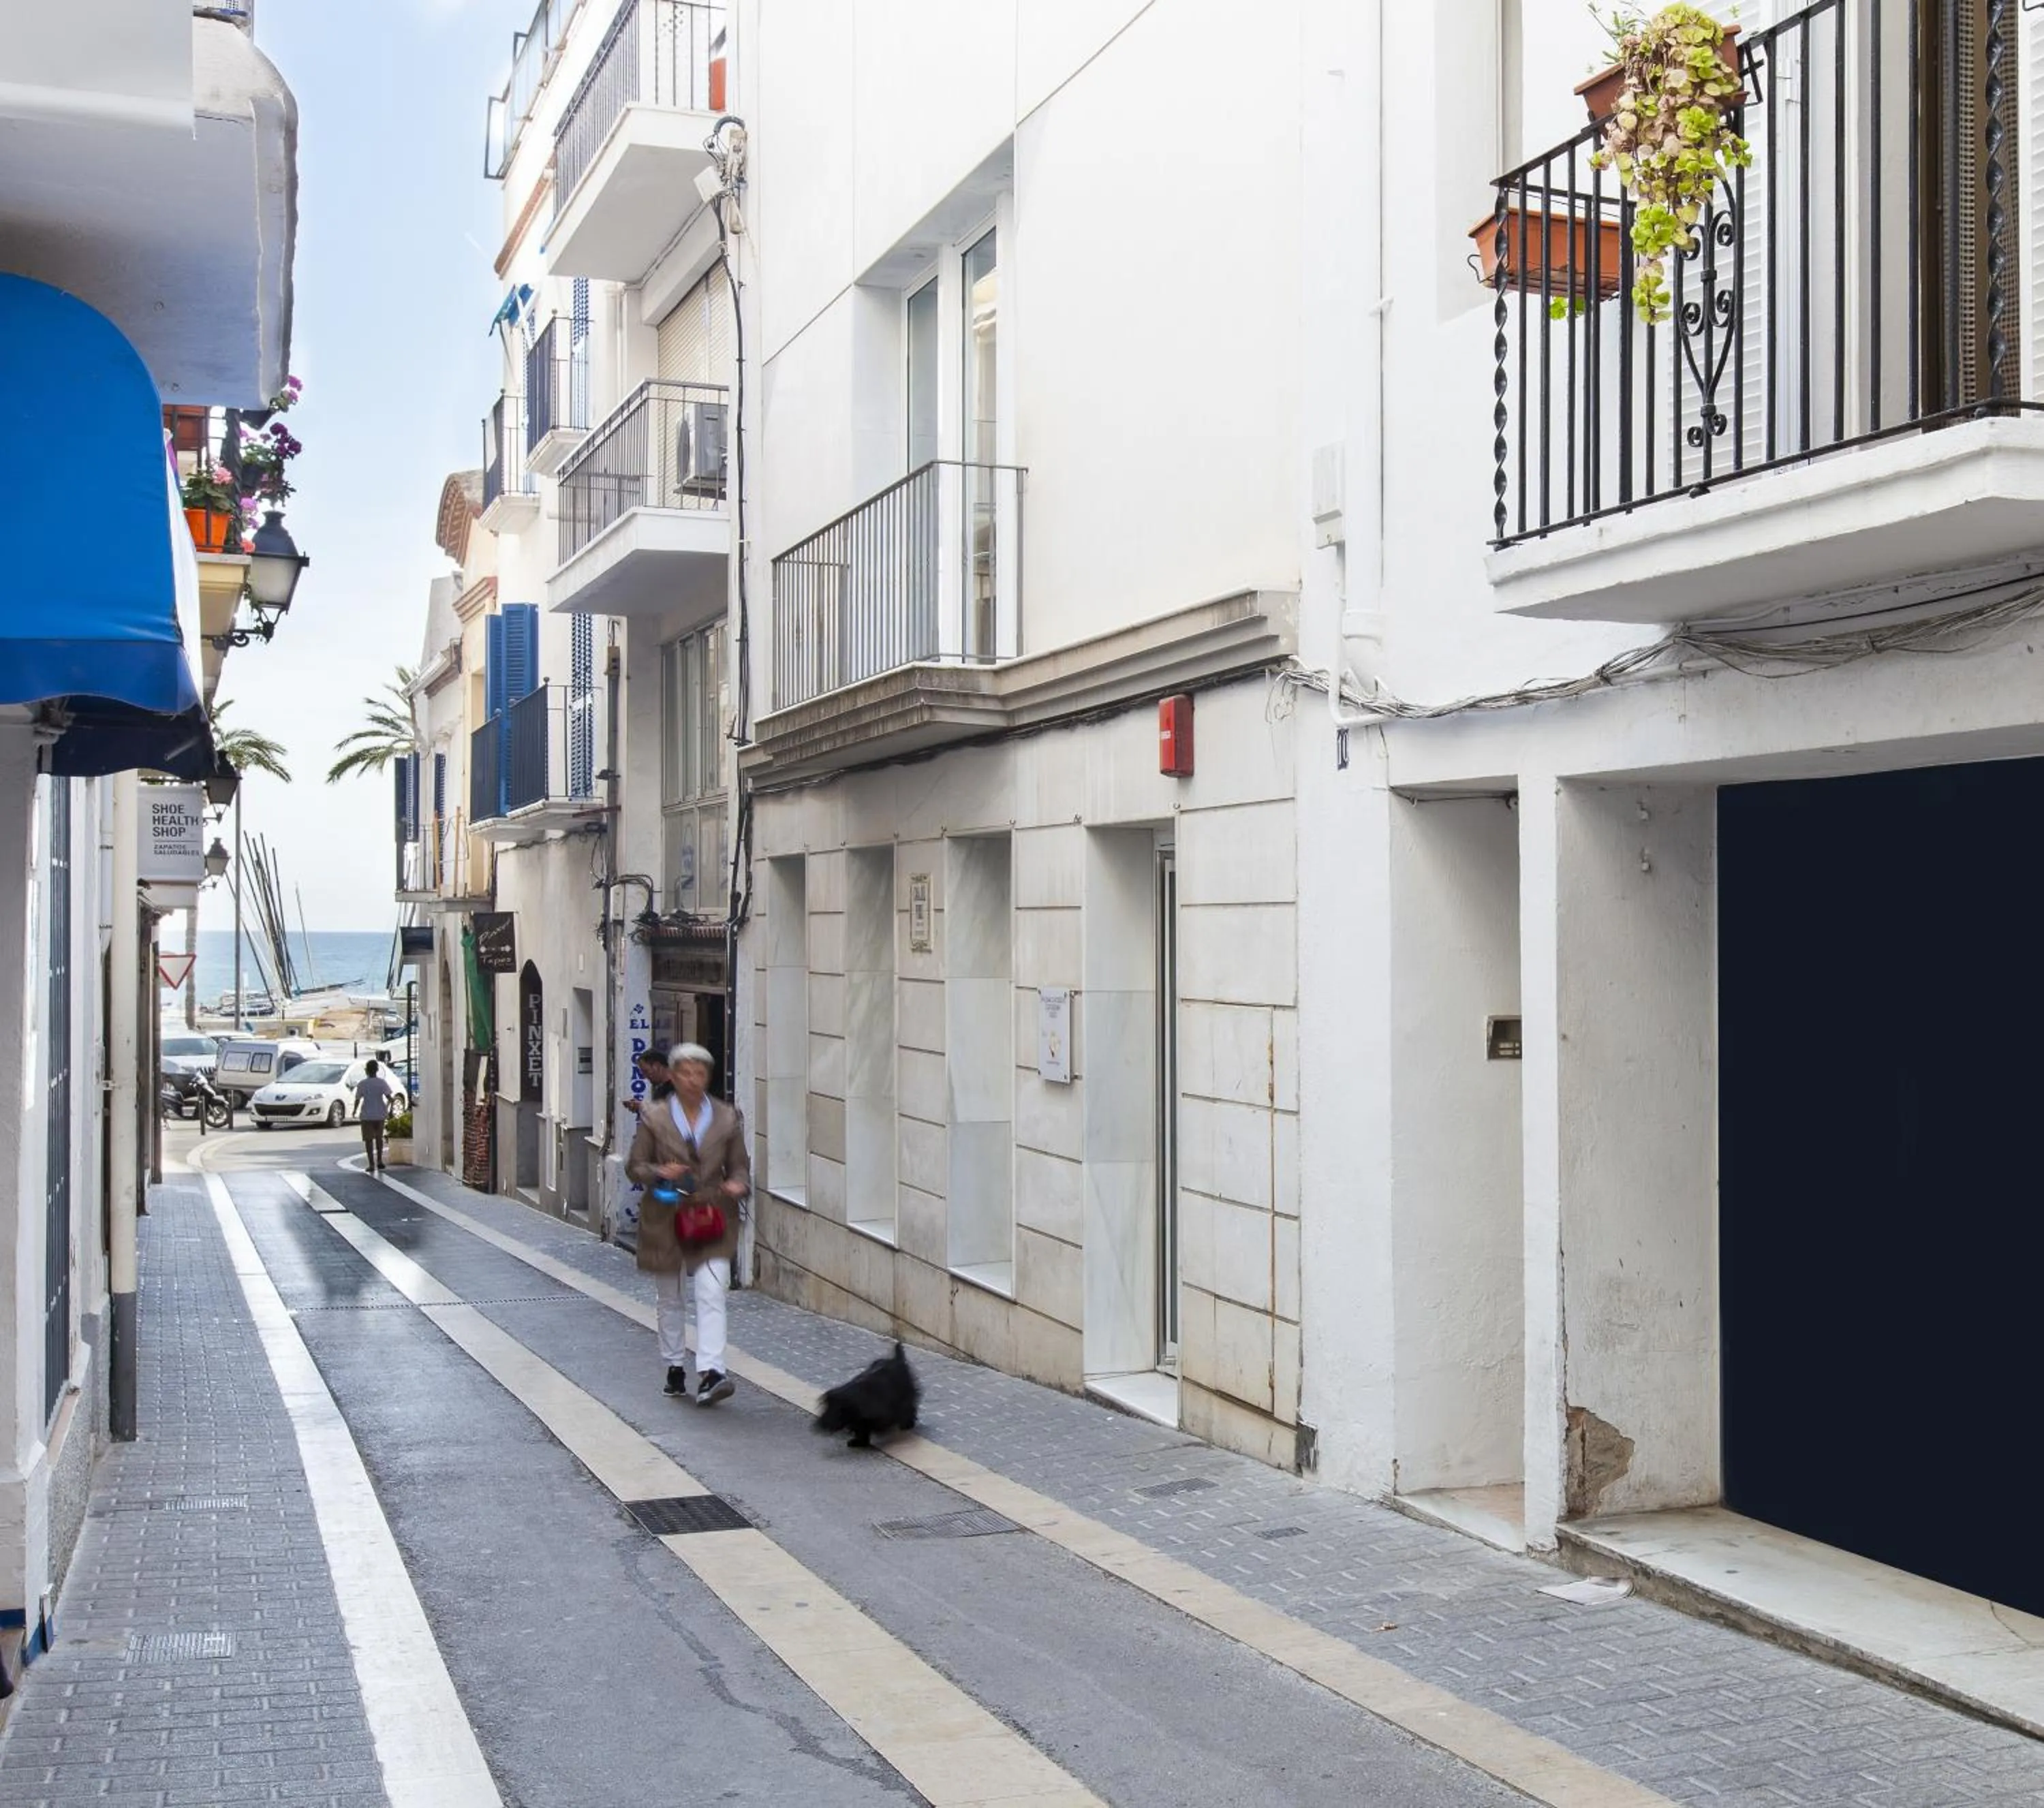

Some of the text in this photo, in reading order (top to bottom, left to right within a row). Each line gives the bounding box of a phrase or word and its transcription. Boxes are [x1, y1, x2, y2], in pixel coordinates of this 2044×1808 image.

[152, 803, 185, 814] SHOE
[152, 815, 199, 826] HEALTH
[152, 826, 186, 837] SHOP
[630, 1019, 649, 1029] EL
[528, 994, 542, 1087] PINXET
